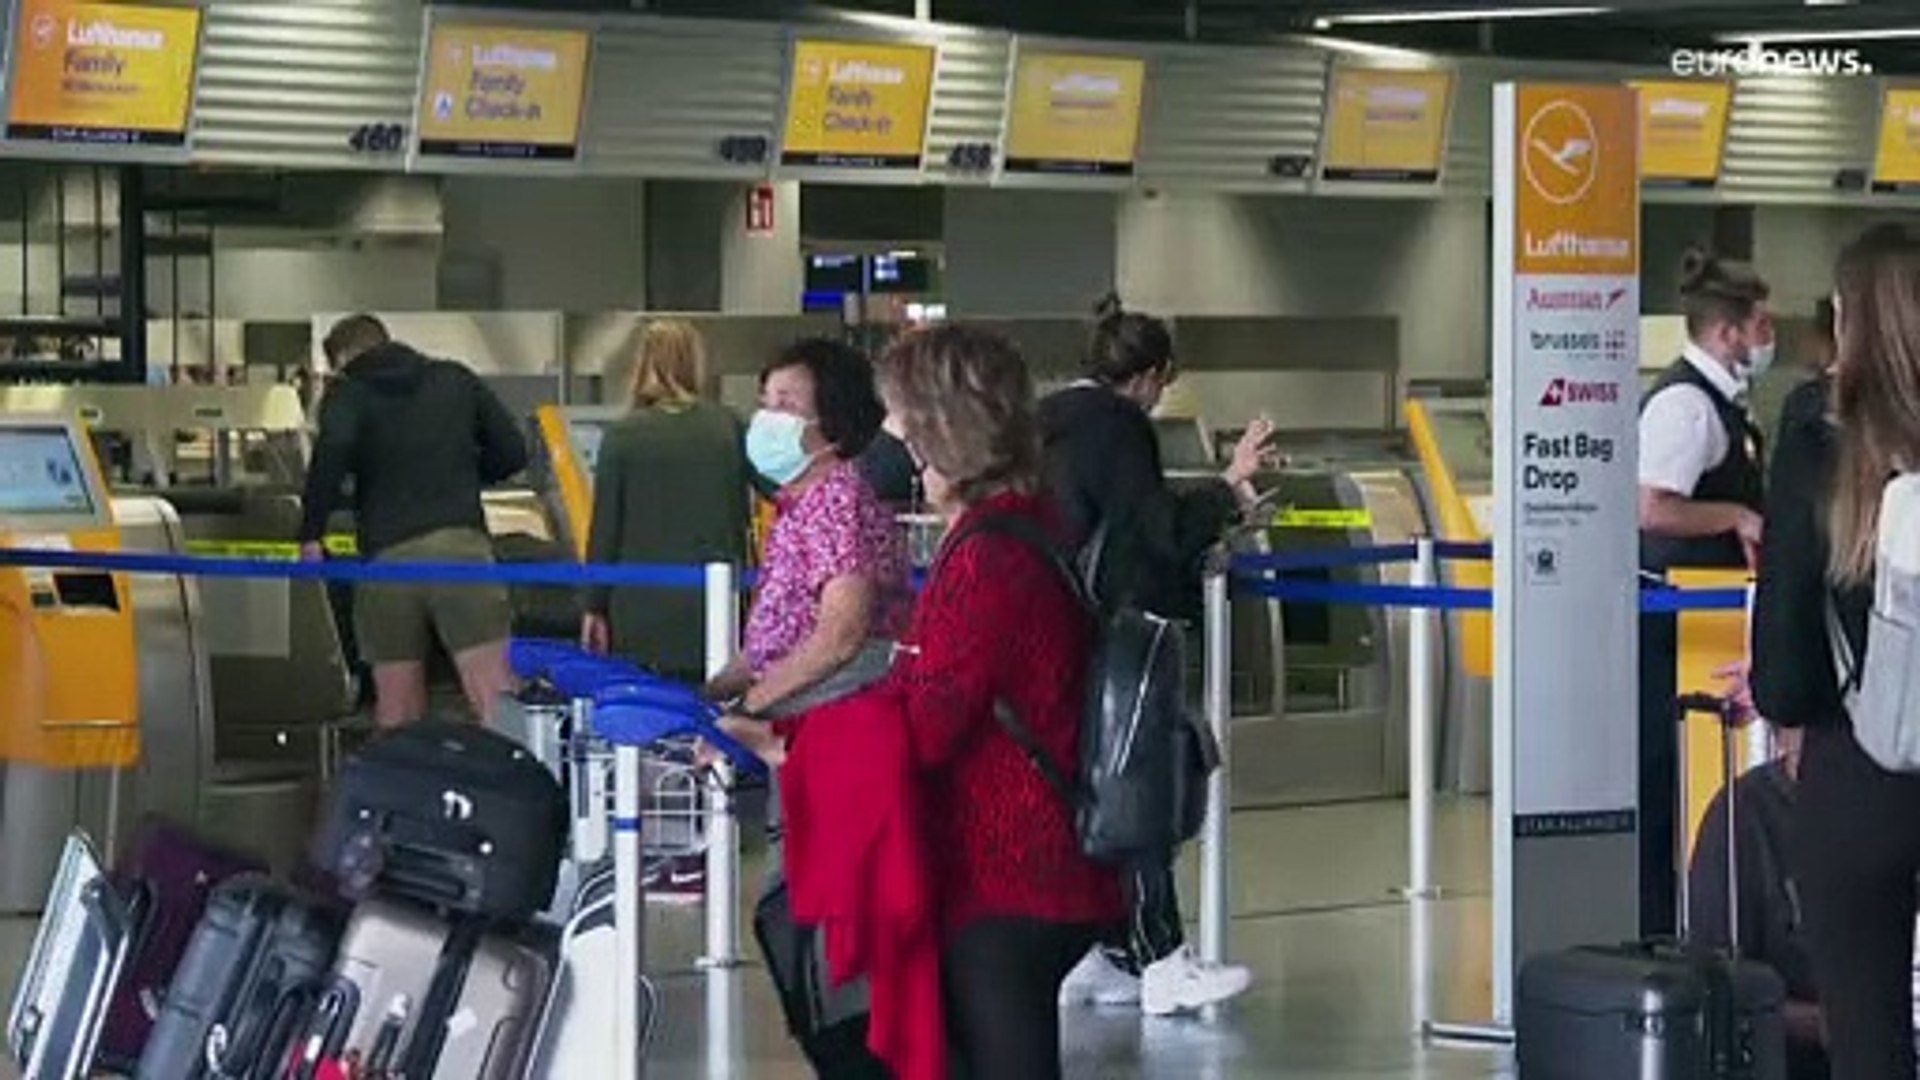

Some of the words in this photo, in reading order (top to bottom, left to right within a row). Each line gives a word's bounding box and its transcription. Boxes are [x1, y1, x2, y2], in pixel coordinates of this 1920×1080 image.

[350, 123, 402, 151] 460
[1567, 382, 1620, 403] SWISS
[1523, 433, 1571, 459] Fast
[1574, 432, 1614, 463] Bag
[1523, 465, 1580, 496] Drop
